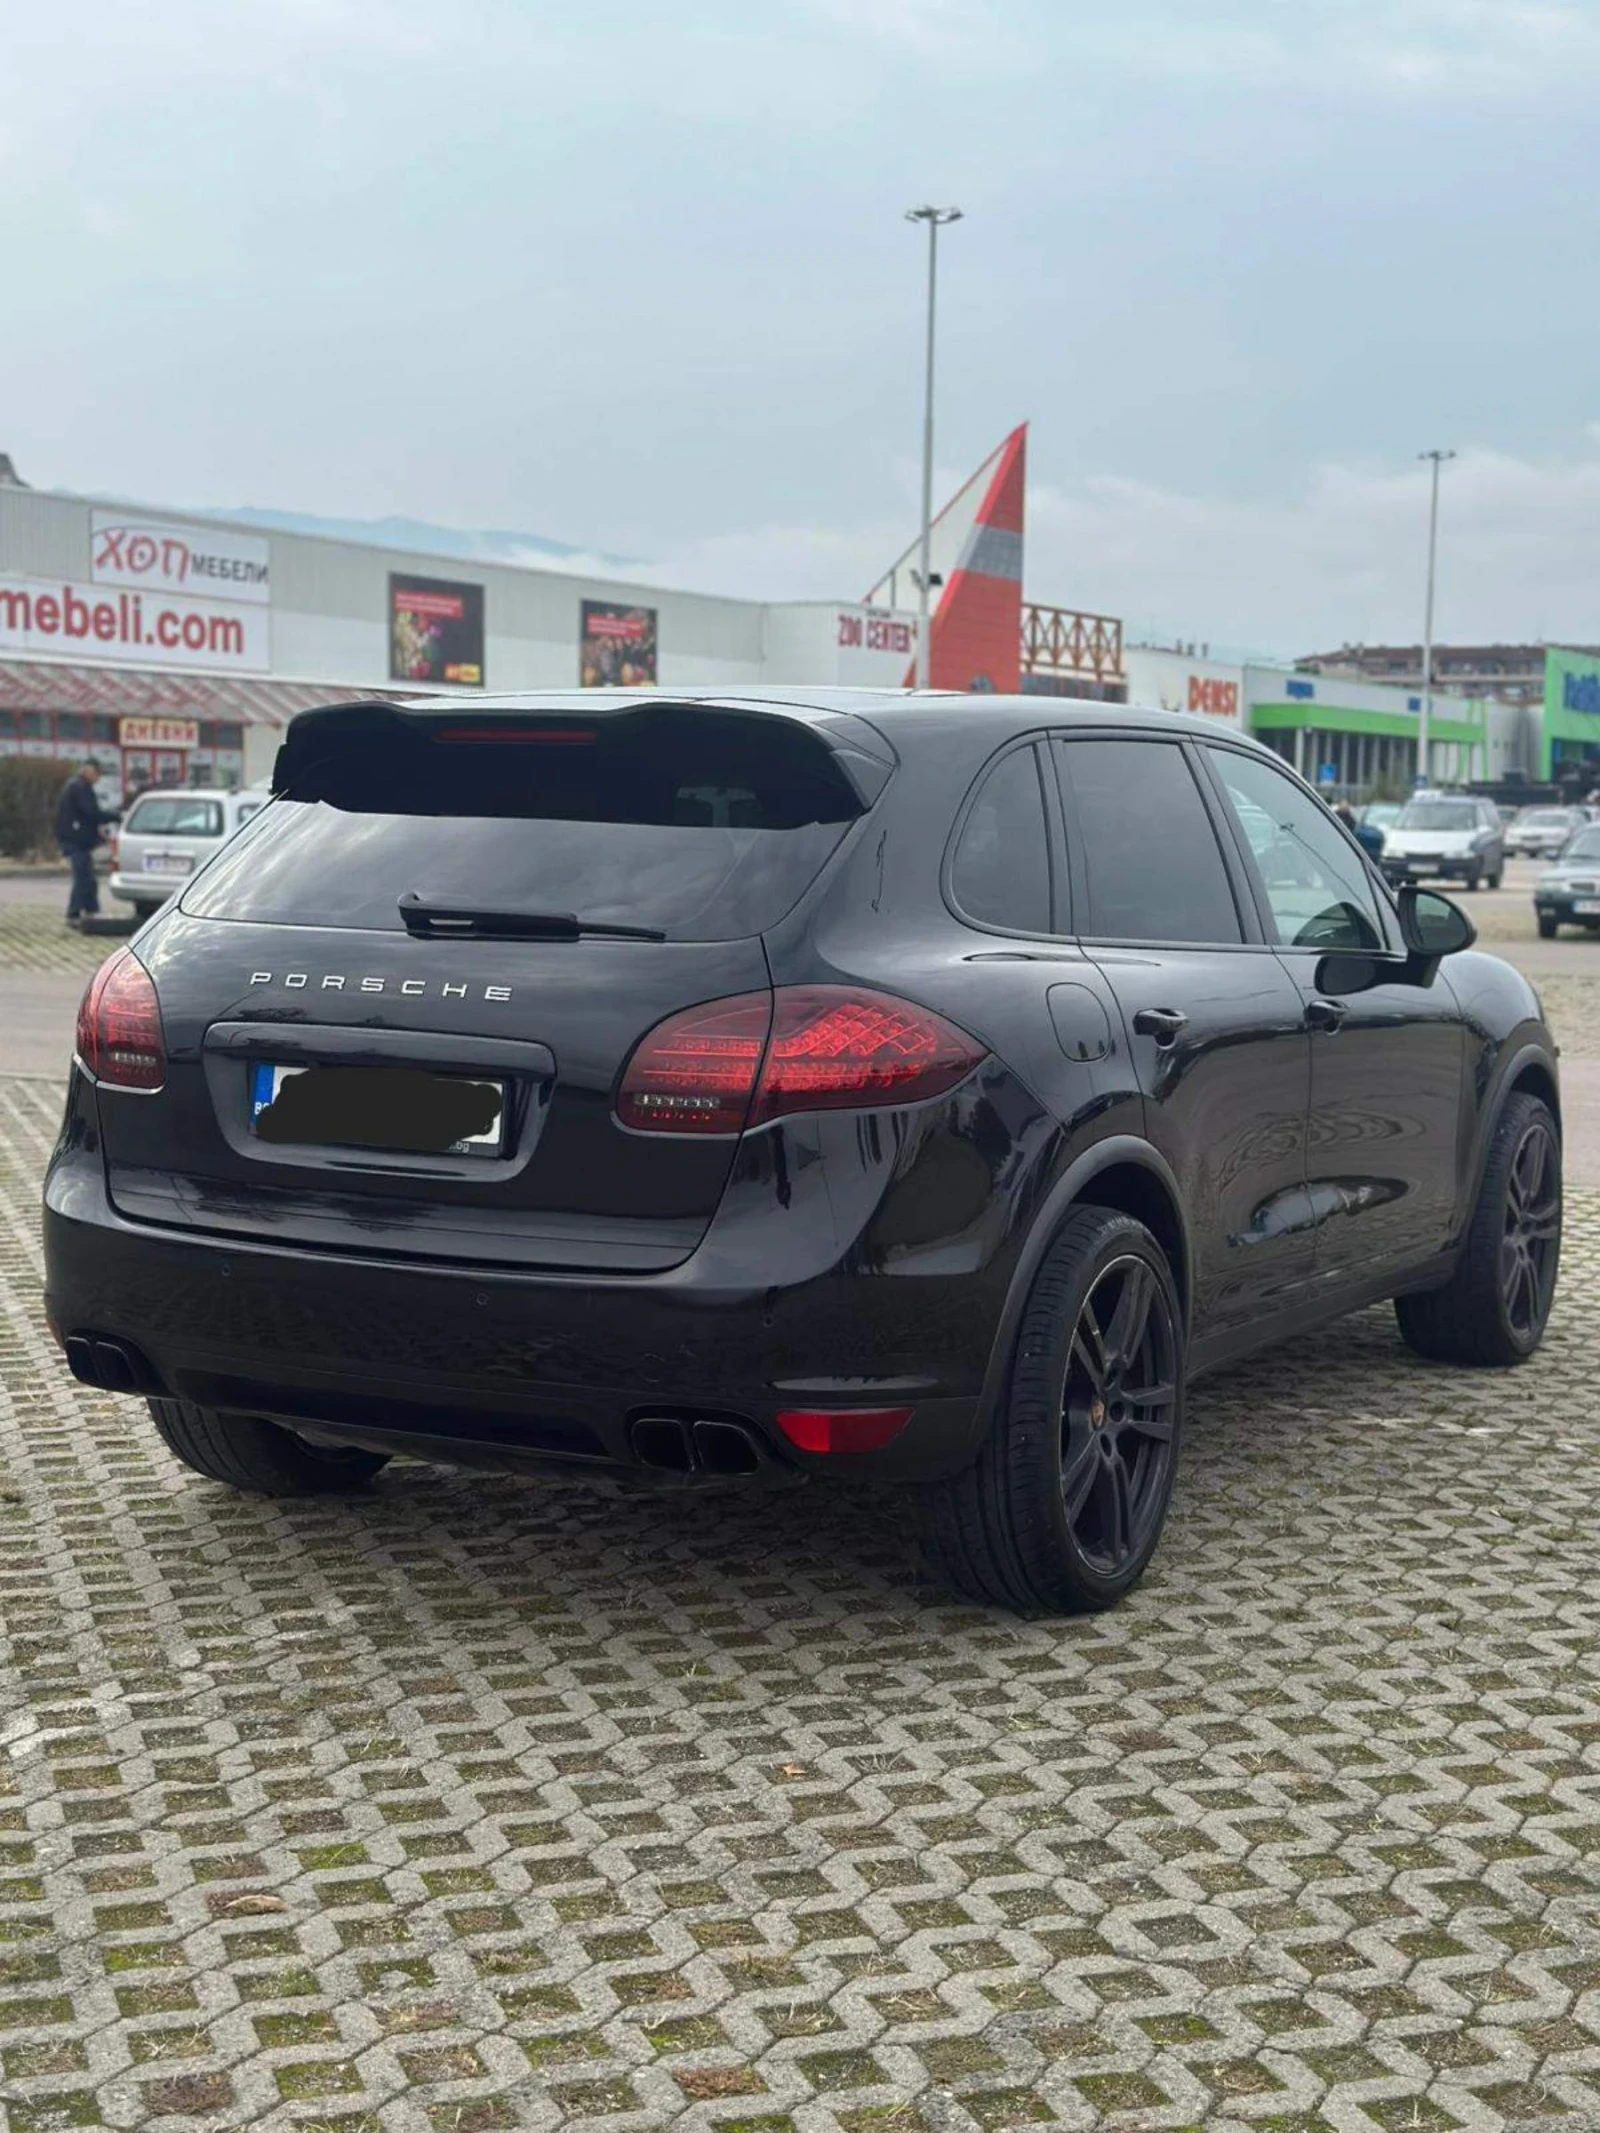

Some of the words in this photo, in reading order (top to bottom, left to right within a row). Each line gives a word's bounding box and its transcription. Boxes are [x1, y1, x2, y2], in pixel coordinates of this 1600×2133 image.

[190, 553, 269, 583] МЕБЕЛИ
[0, 584, 244, 654] mebeli.com
[838, 614, 862, 648] ZOO
[867, 619, 910, 653] CENTER
[250, 972, 513, 1001] PORSCHE
